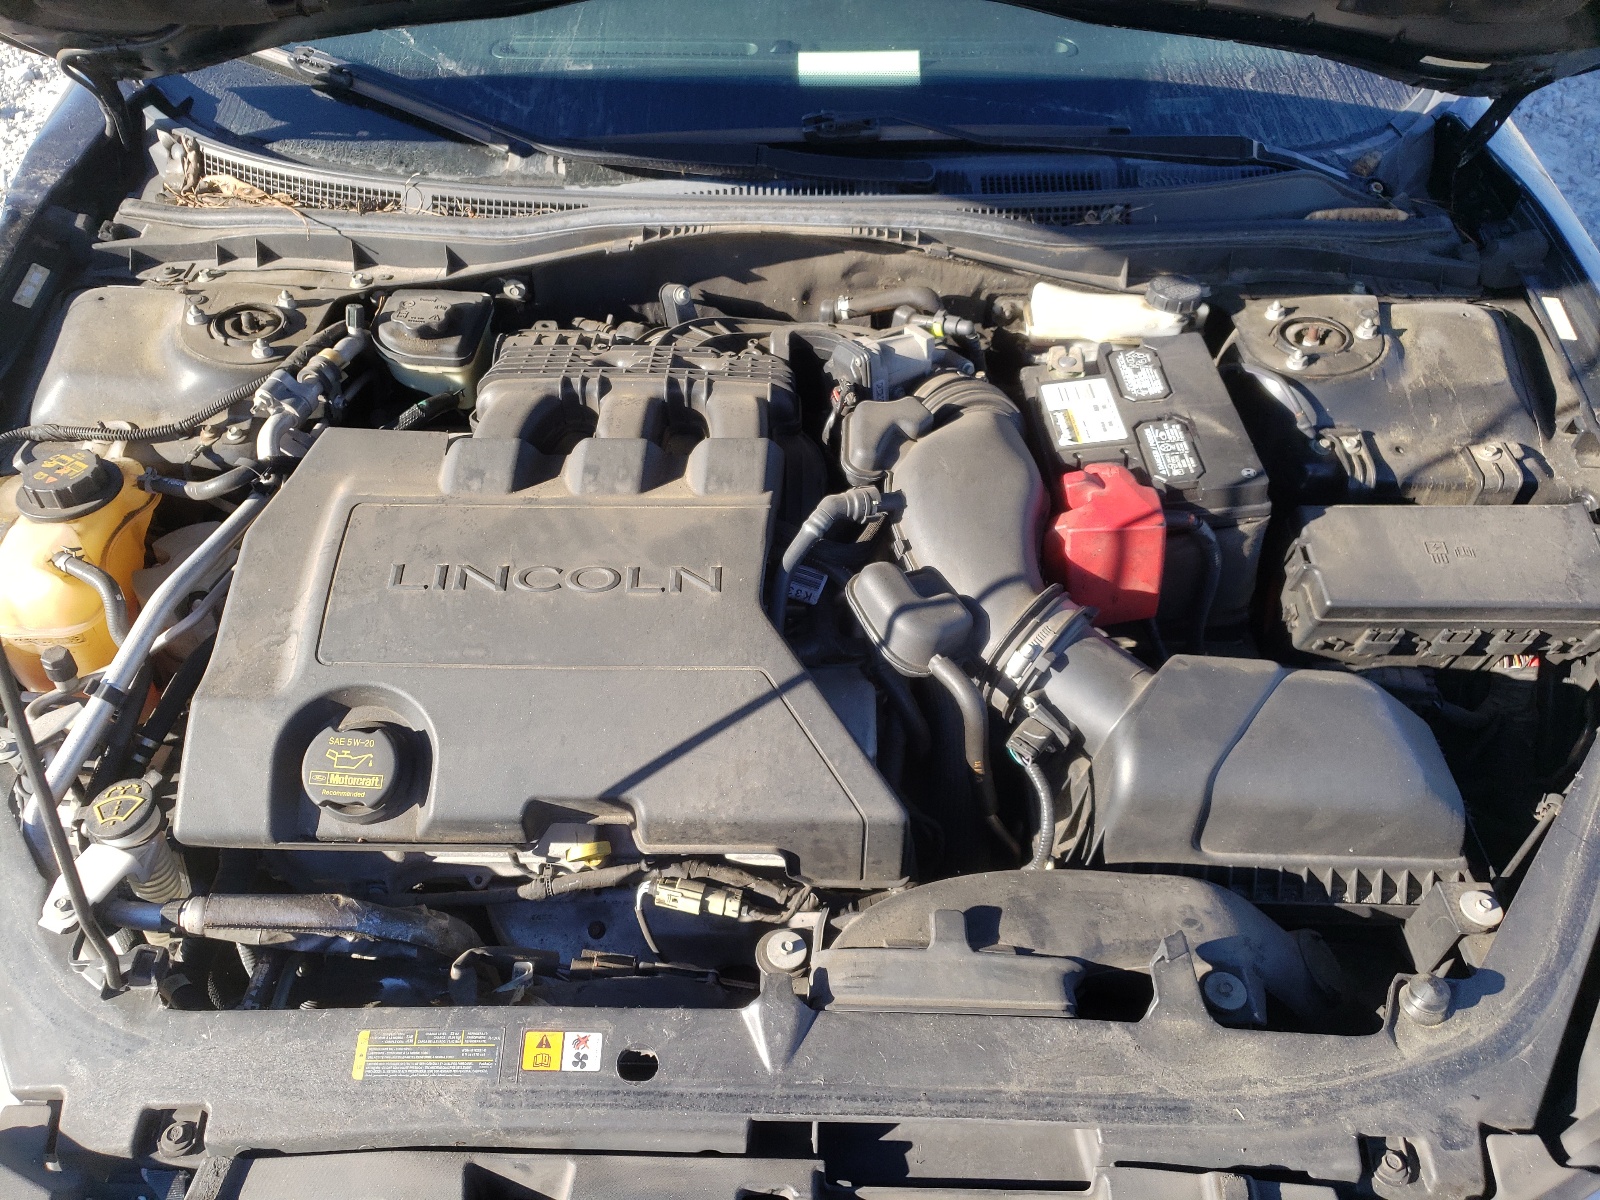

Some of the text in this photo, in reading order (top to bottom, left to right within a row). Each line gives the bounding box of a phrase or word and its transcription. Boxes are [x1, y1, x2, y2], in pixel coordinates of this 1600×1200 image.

[387, 563, 723, 594] LINCOLN
[329, 737, 375, 748] SAE 5W-20
[329, 773, 380, 787] Motorcraft
[322, 789, 365, 798] Recommended
